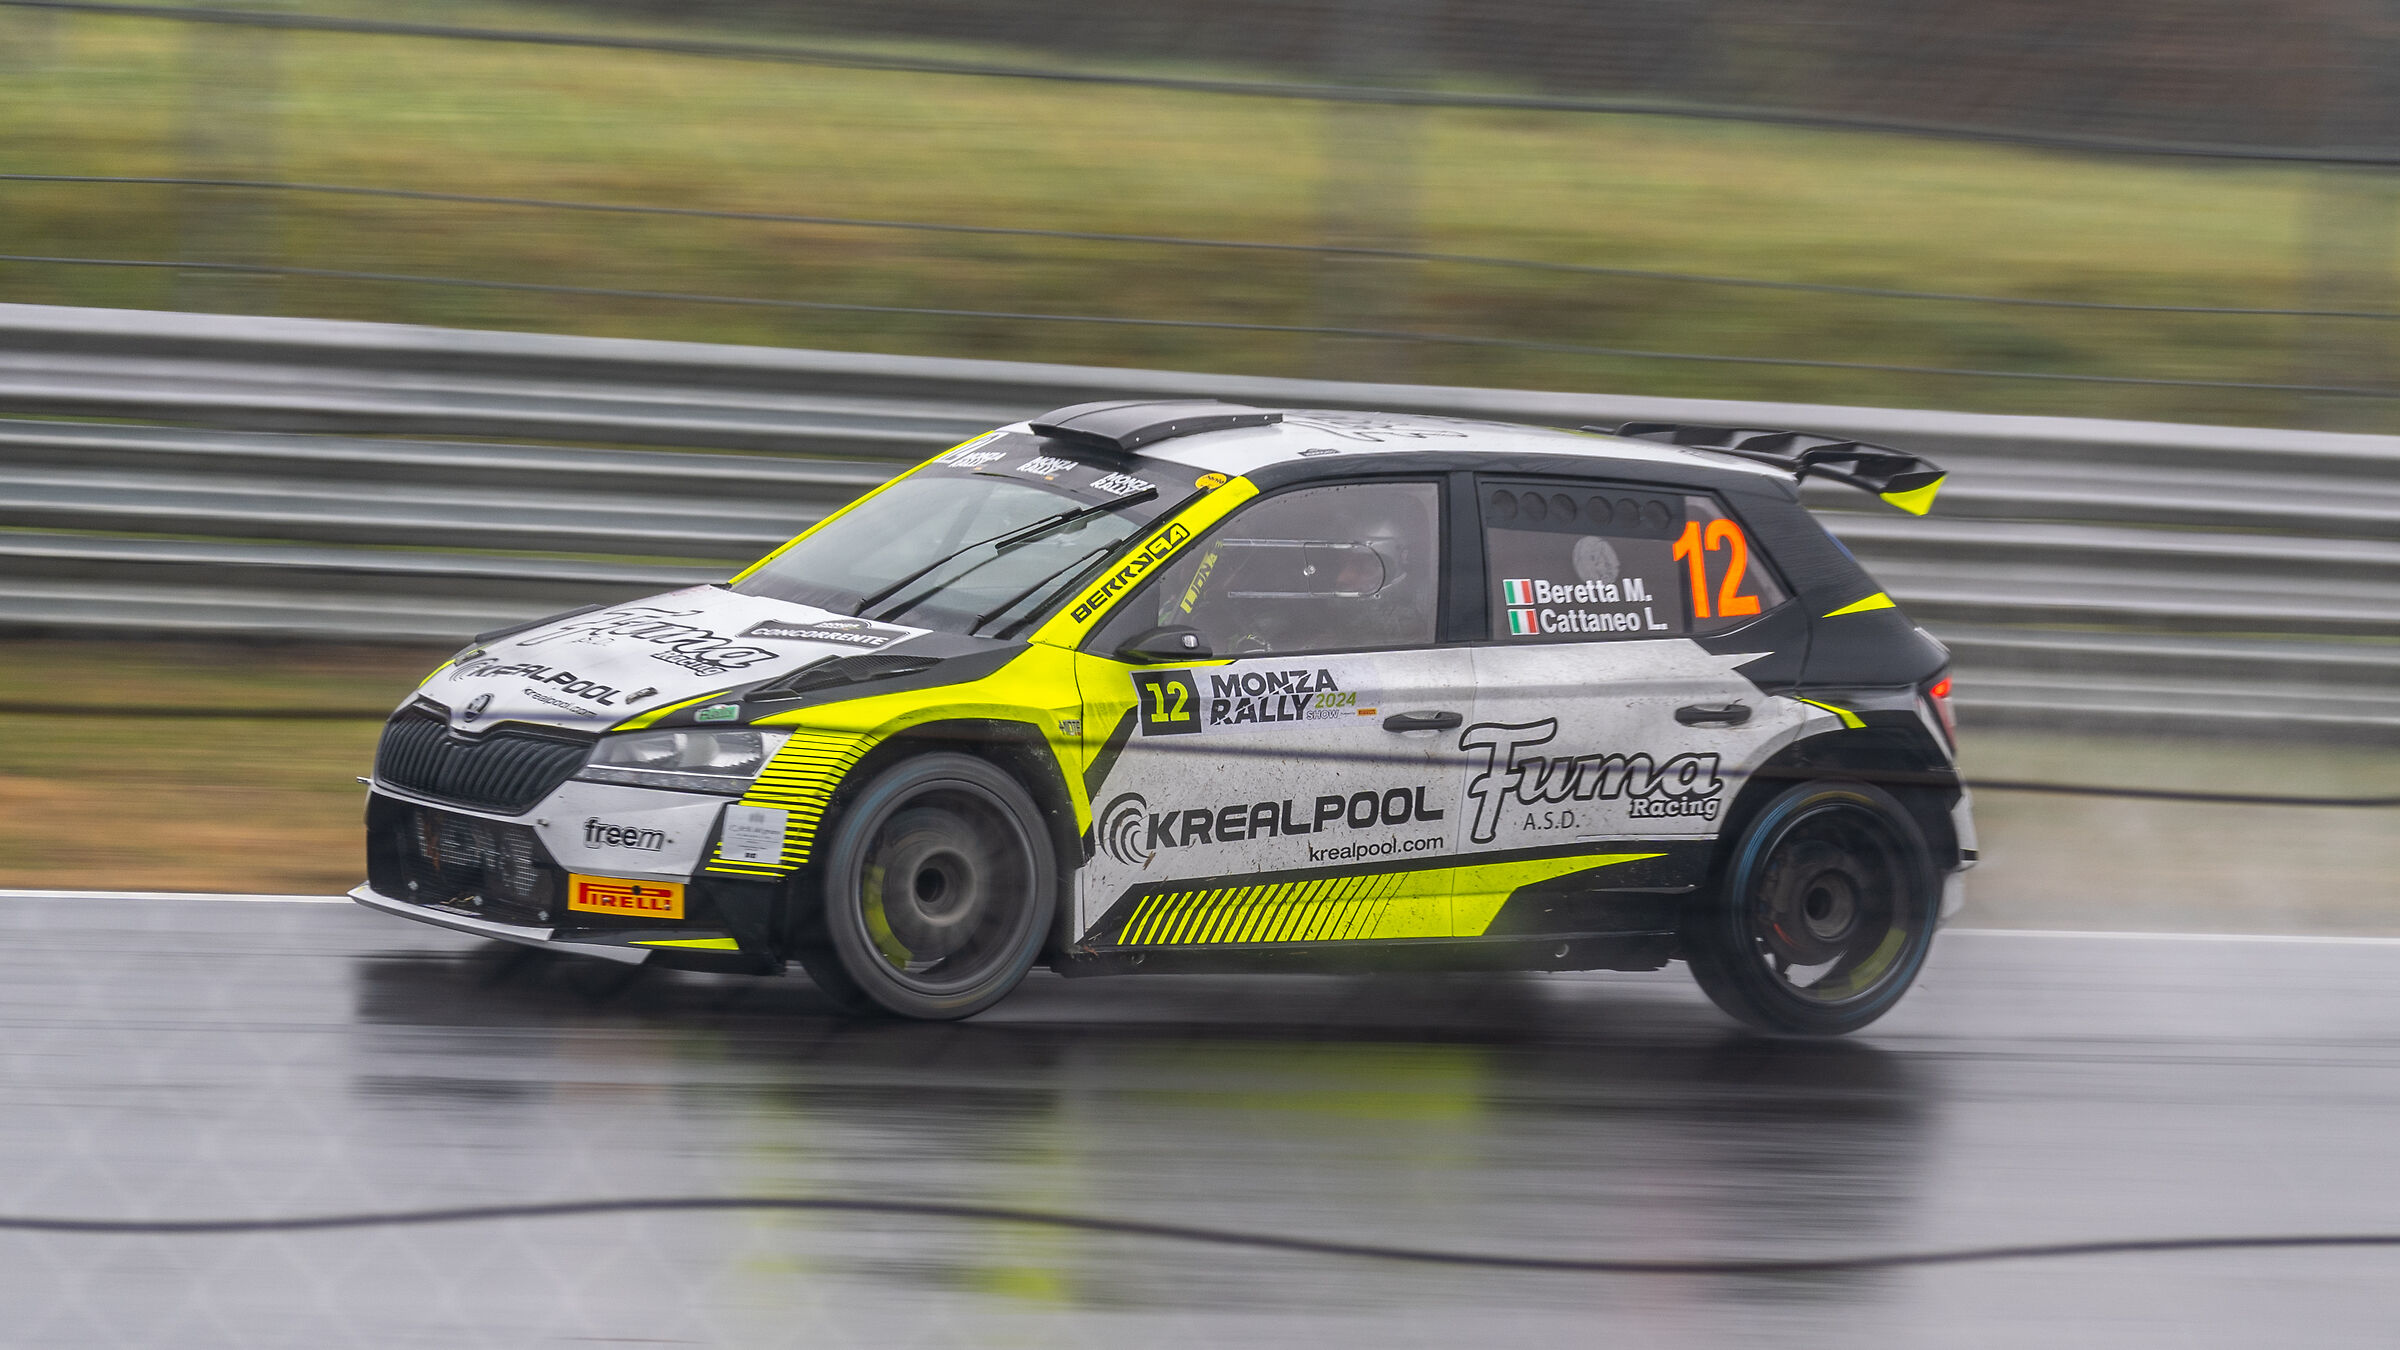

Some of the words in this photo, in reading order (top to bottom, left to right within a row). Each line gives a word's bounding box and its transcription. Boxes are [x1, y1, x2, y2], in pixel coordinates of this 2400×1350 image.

[1016, 462, 1055, 476] RALLY
[1031, 456, 1079, 471] MONZA
[1089, 478, 1134, 496] RALLY
[1672, 518, 1761, 618] 12
[1533, 579, 1621, 604] Beretta
[1622, 577, 1653, 602] M.
[1538, 609, 1642, 634] Cattaneo
[1644, 607, 1669, 631] L.
[751, 627, 890, 646] CONCORRENTE
[650, 650, 728, 677] Racing
[1210, 669, 1339, 698] MONZA
[1145, 681, 1190, 723] 12
[1210, 694, 1314, 726] RALLY
[1314, 691, 1358, 709] 2024
[1306, 709, 1340, 721] SHOW
[1458, 717, 1723, 843] Fuma
[1146, 786, 1445, 850] KREALPOOL
[1523, 811, 1580, 831] A.S.D.
[1629, 797, 1721, 821] Racing
[583, 816, 665, 852] freem
[1309, 836, 1444, 863] krealpool.com
[578, 882, 673, 911] PIRELLI
